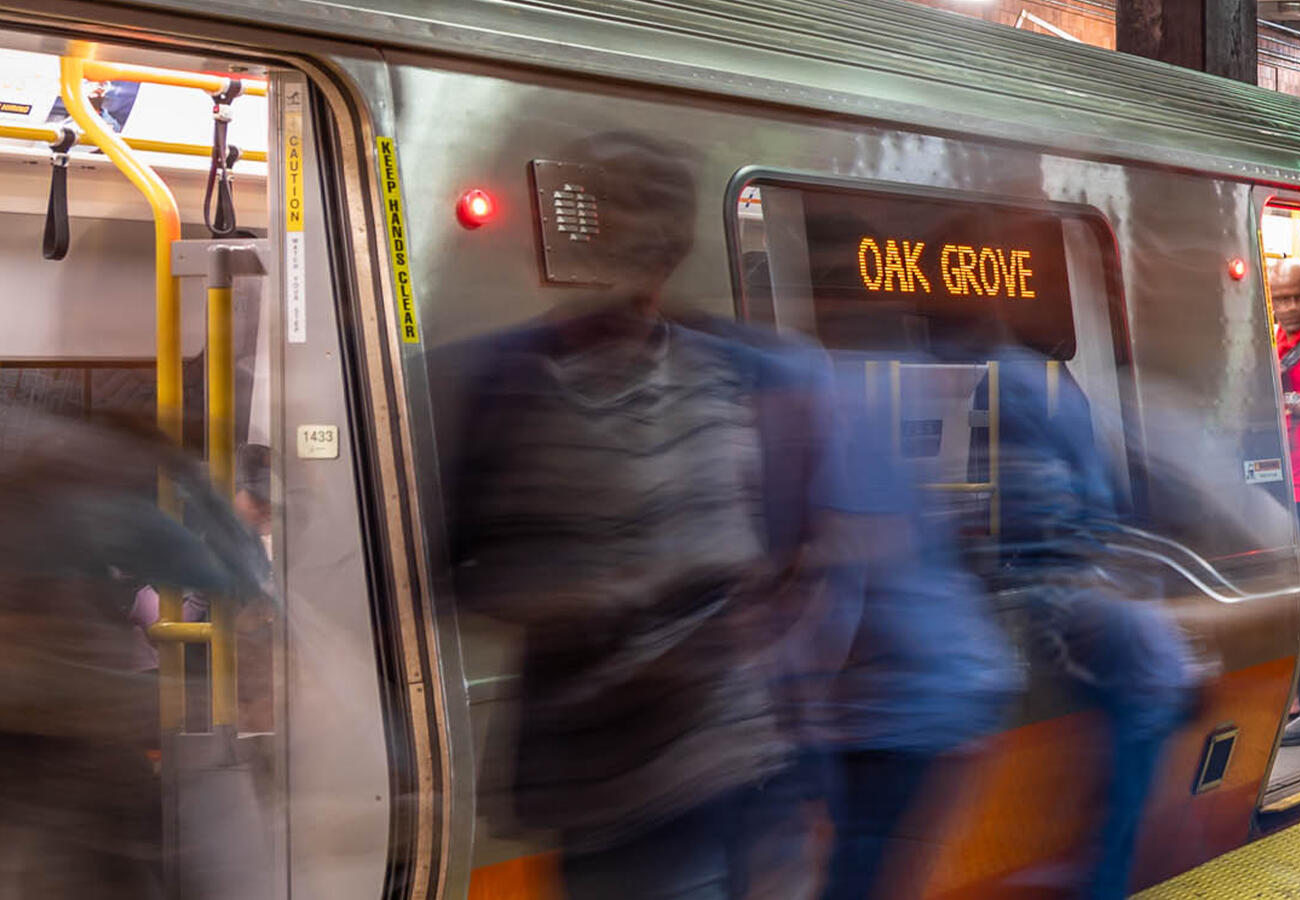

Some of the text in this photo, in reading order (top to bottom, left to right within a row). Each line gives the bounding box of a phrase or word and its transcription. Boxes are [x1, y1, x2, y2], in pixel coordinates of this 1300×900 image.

[289, 136, 300, 221] CAUTION
[381, 141, 415, 338] KEEP HANDS CLEAR
[858, 238, 1036, 298] OAK GROVE
[304, 431, 333, 442] 1433
